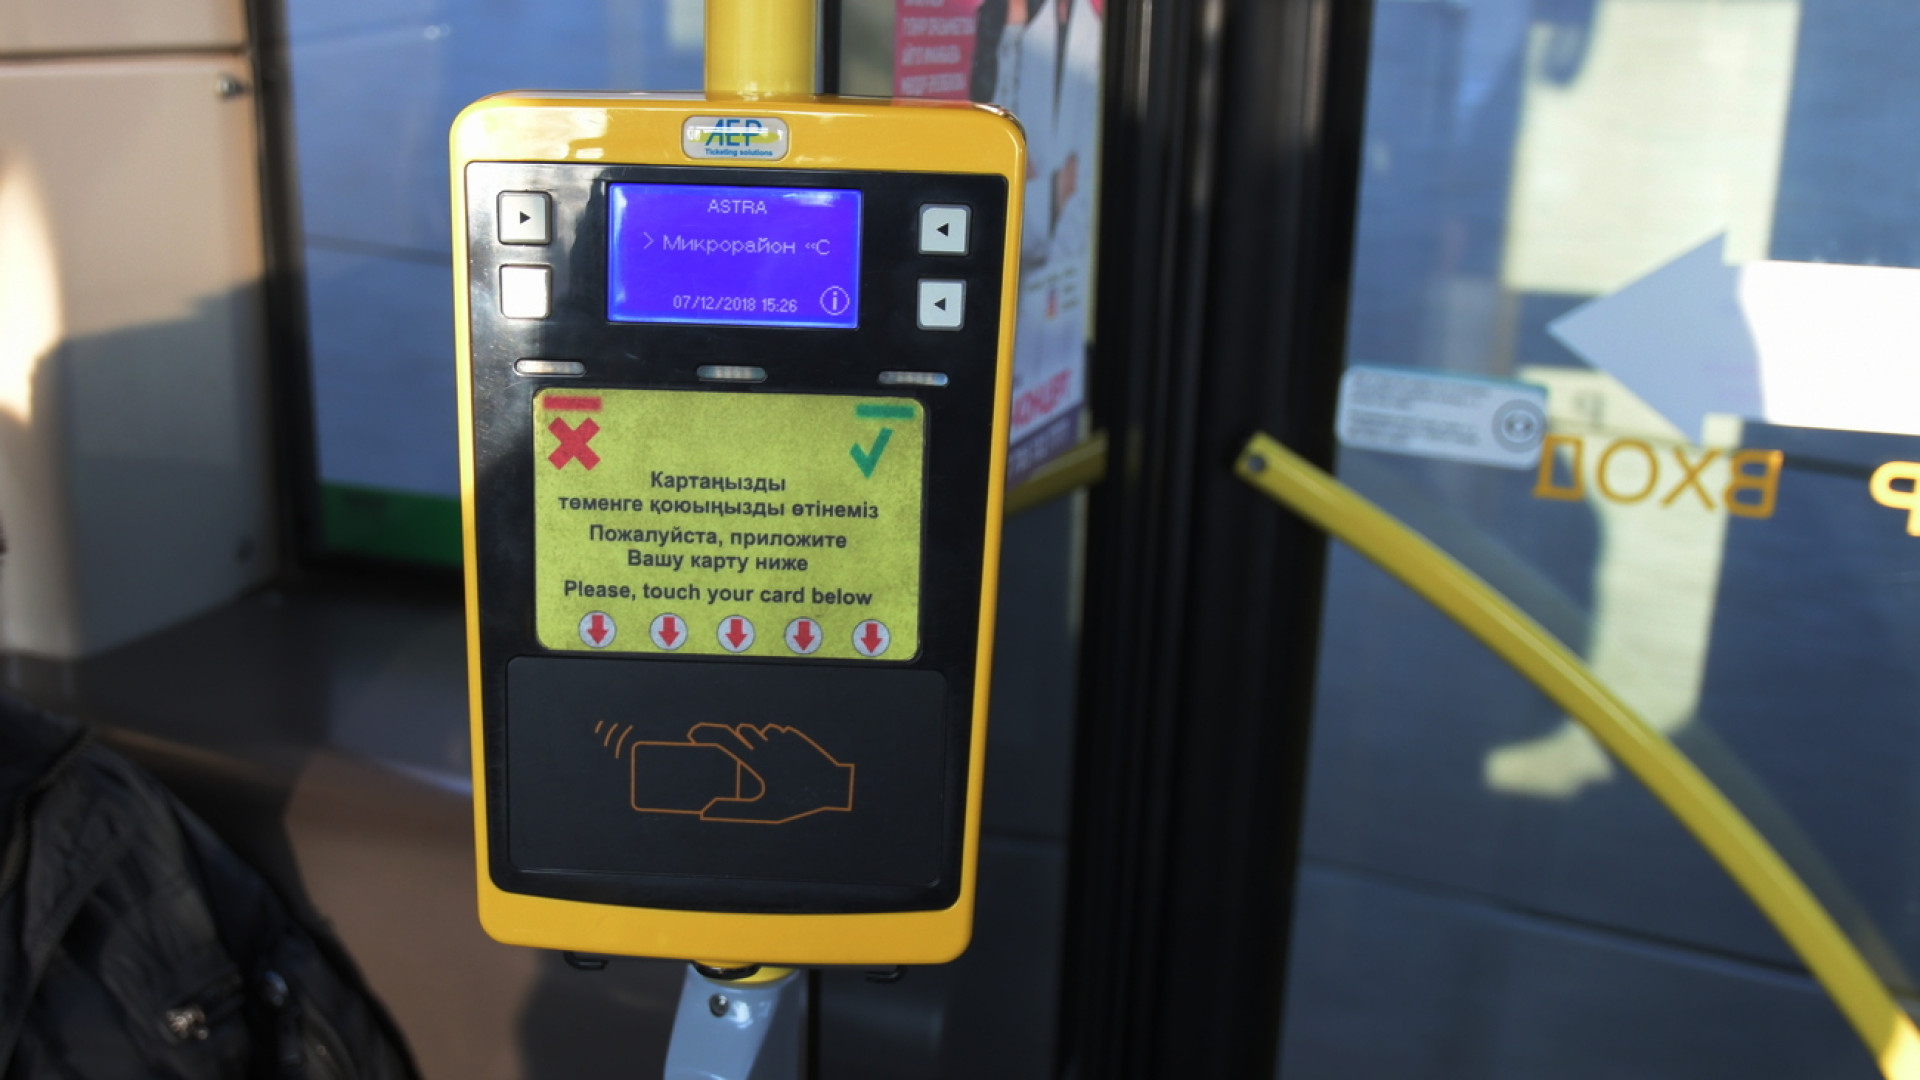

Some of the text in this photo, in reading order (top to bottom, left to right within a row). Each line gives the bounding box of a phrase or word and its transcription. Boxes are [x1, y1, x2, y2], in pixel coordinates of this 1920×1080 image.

[705, 118, 762, 147] AEP
[705, 148, 738, 157] Ticketing
[707, 199, 768, 214] ASTRA
[663, 234, 796, 256] Микрорайон
[672, 295, 798, 313] 07/12/2018 15:26
[650, 471, 787, 492] Картаңызды
[558, 496, 879, 519] төменге қоюыңызды өтінеміз
[589, 524, 848, 549] Пожалуйста, приложите
[628, 550, 809, 573] Вашу карту ниже
[564, 580, 873, 606] Please, touch your card below
